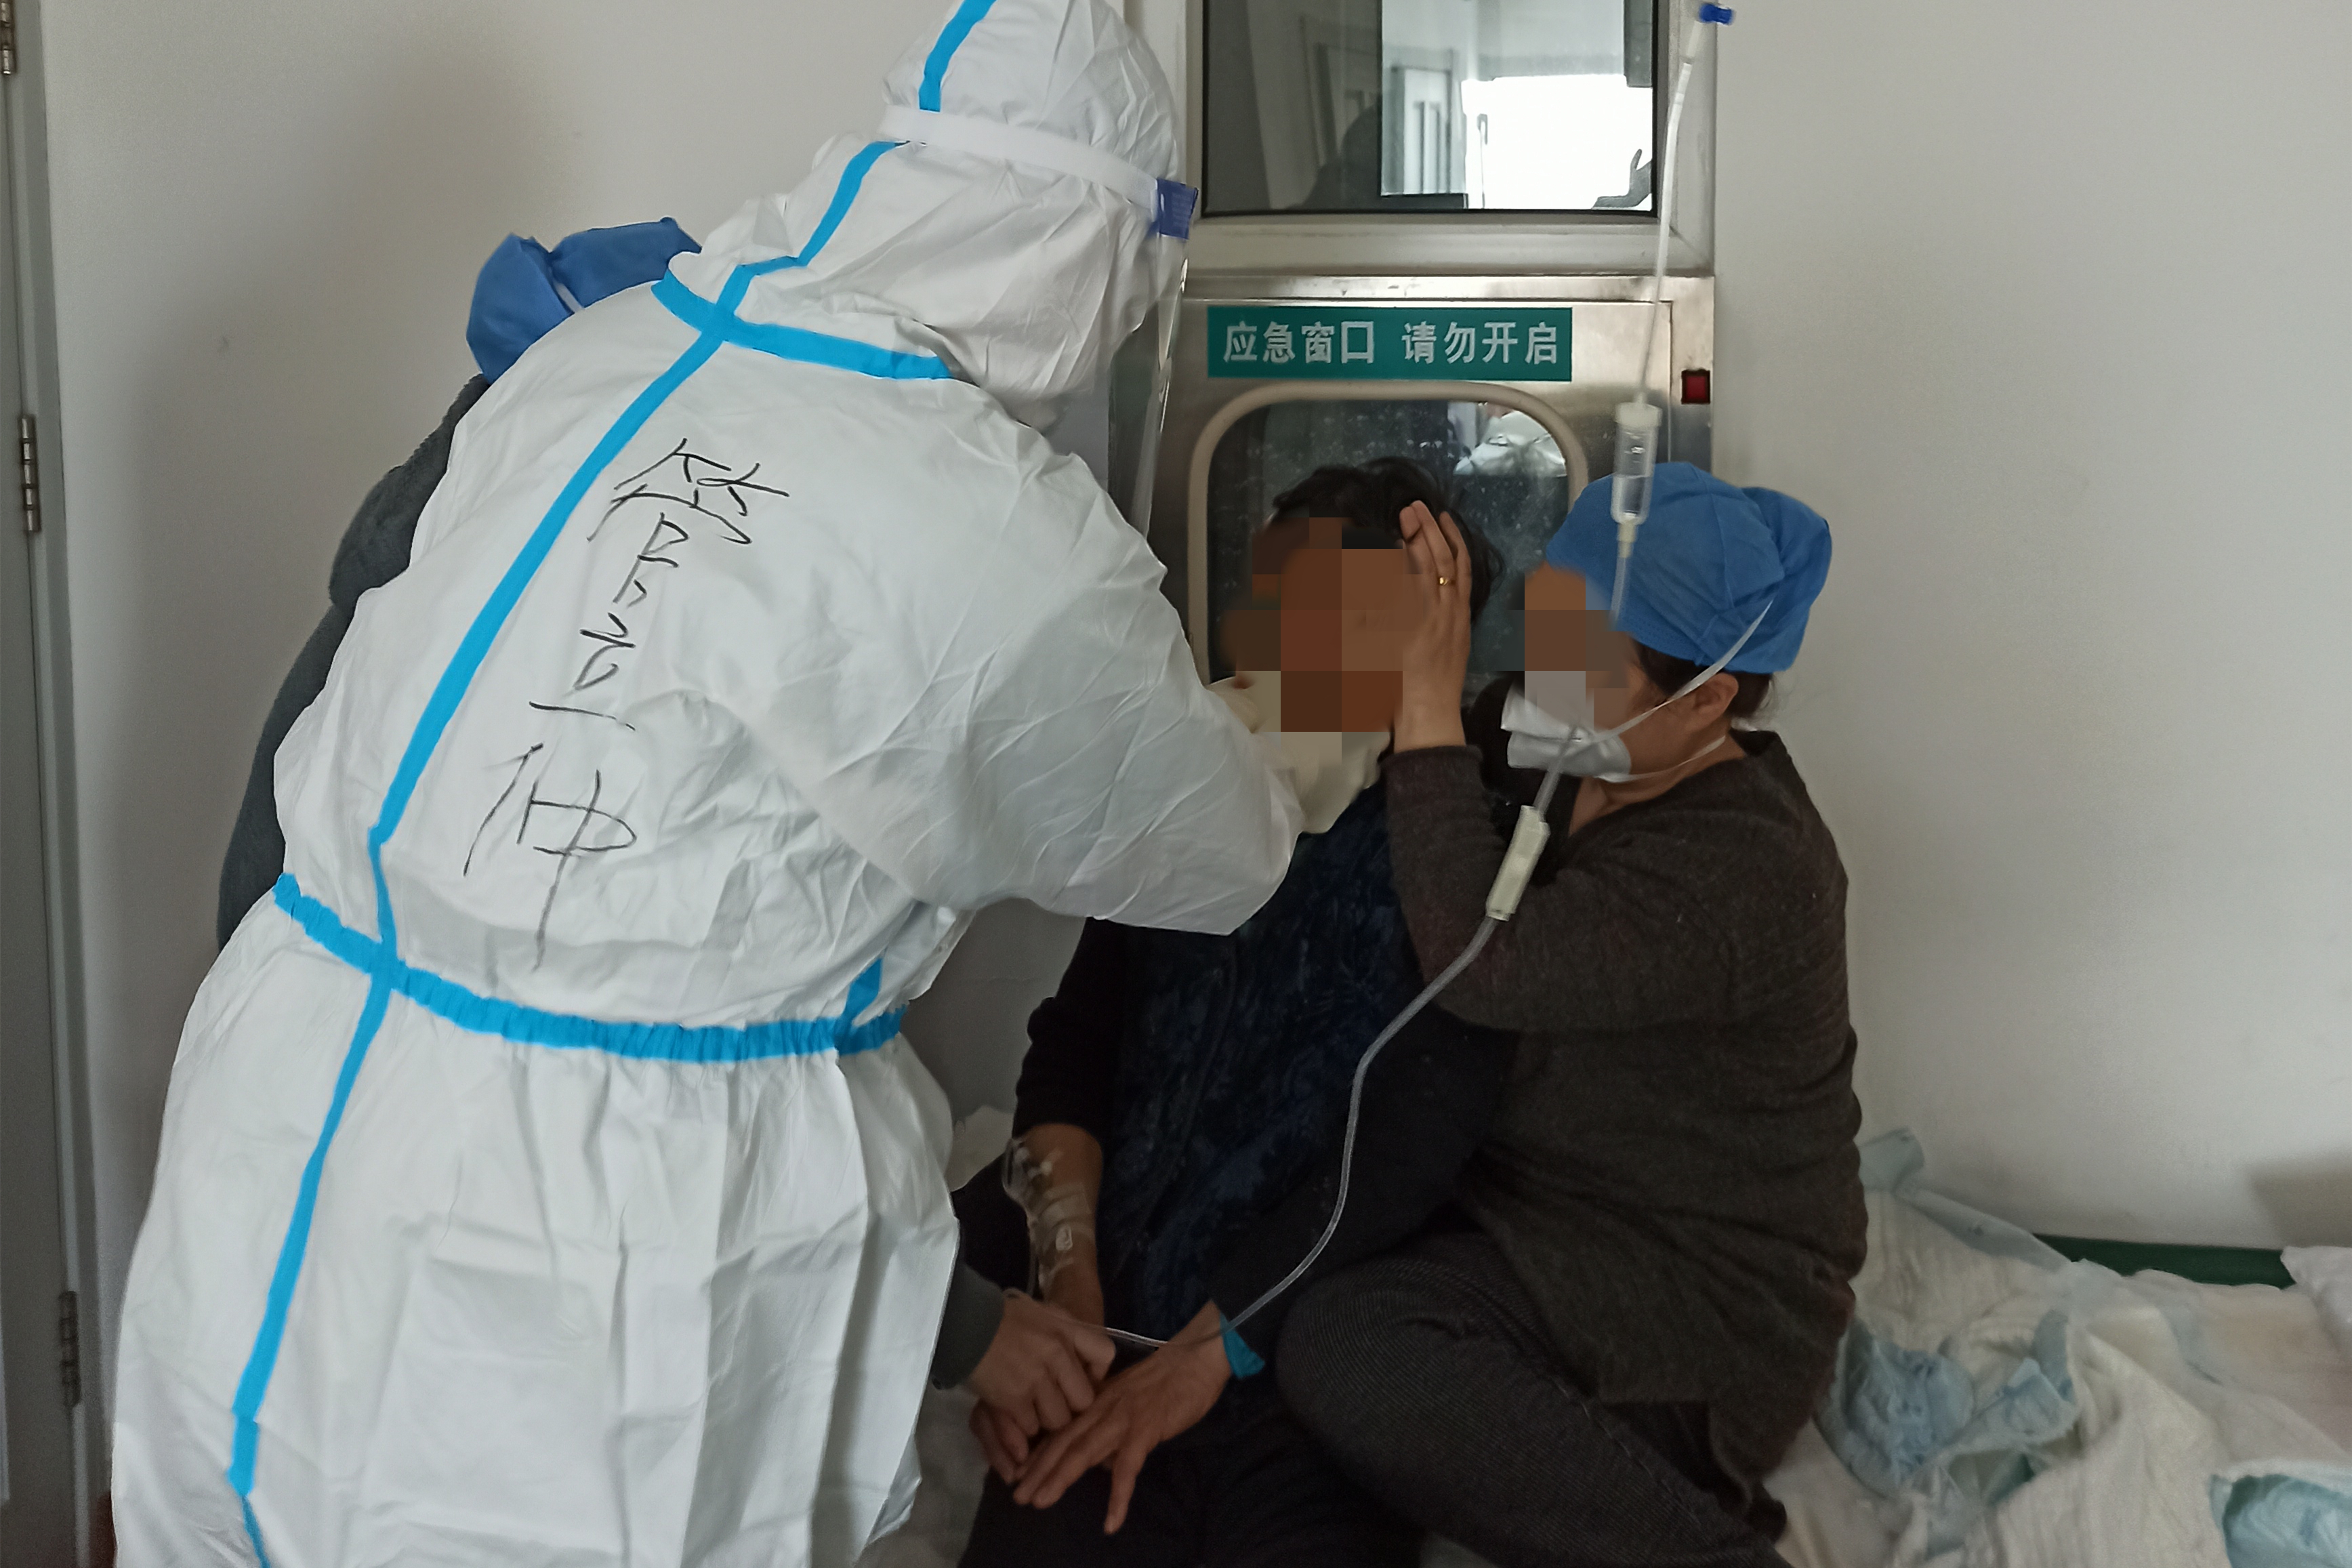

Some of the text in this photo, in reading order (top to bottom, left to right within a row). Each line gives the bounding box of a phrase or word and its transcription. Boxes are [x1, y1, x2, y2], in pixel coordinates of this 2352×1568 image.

[1223, 321, 1557, 365] 应急窗口 请勿开启
